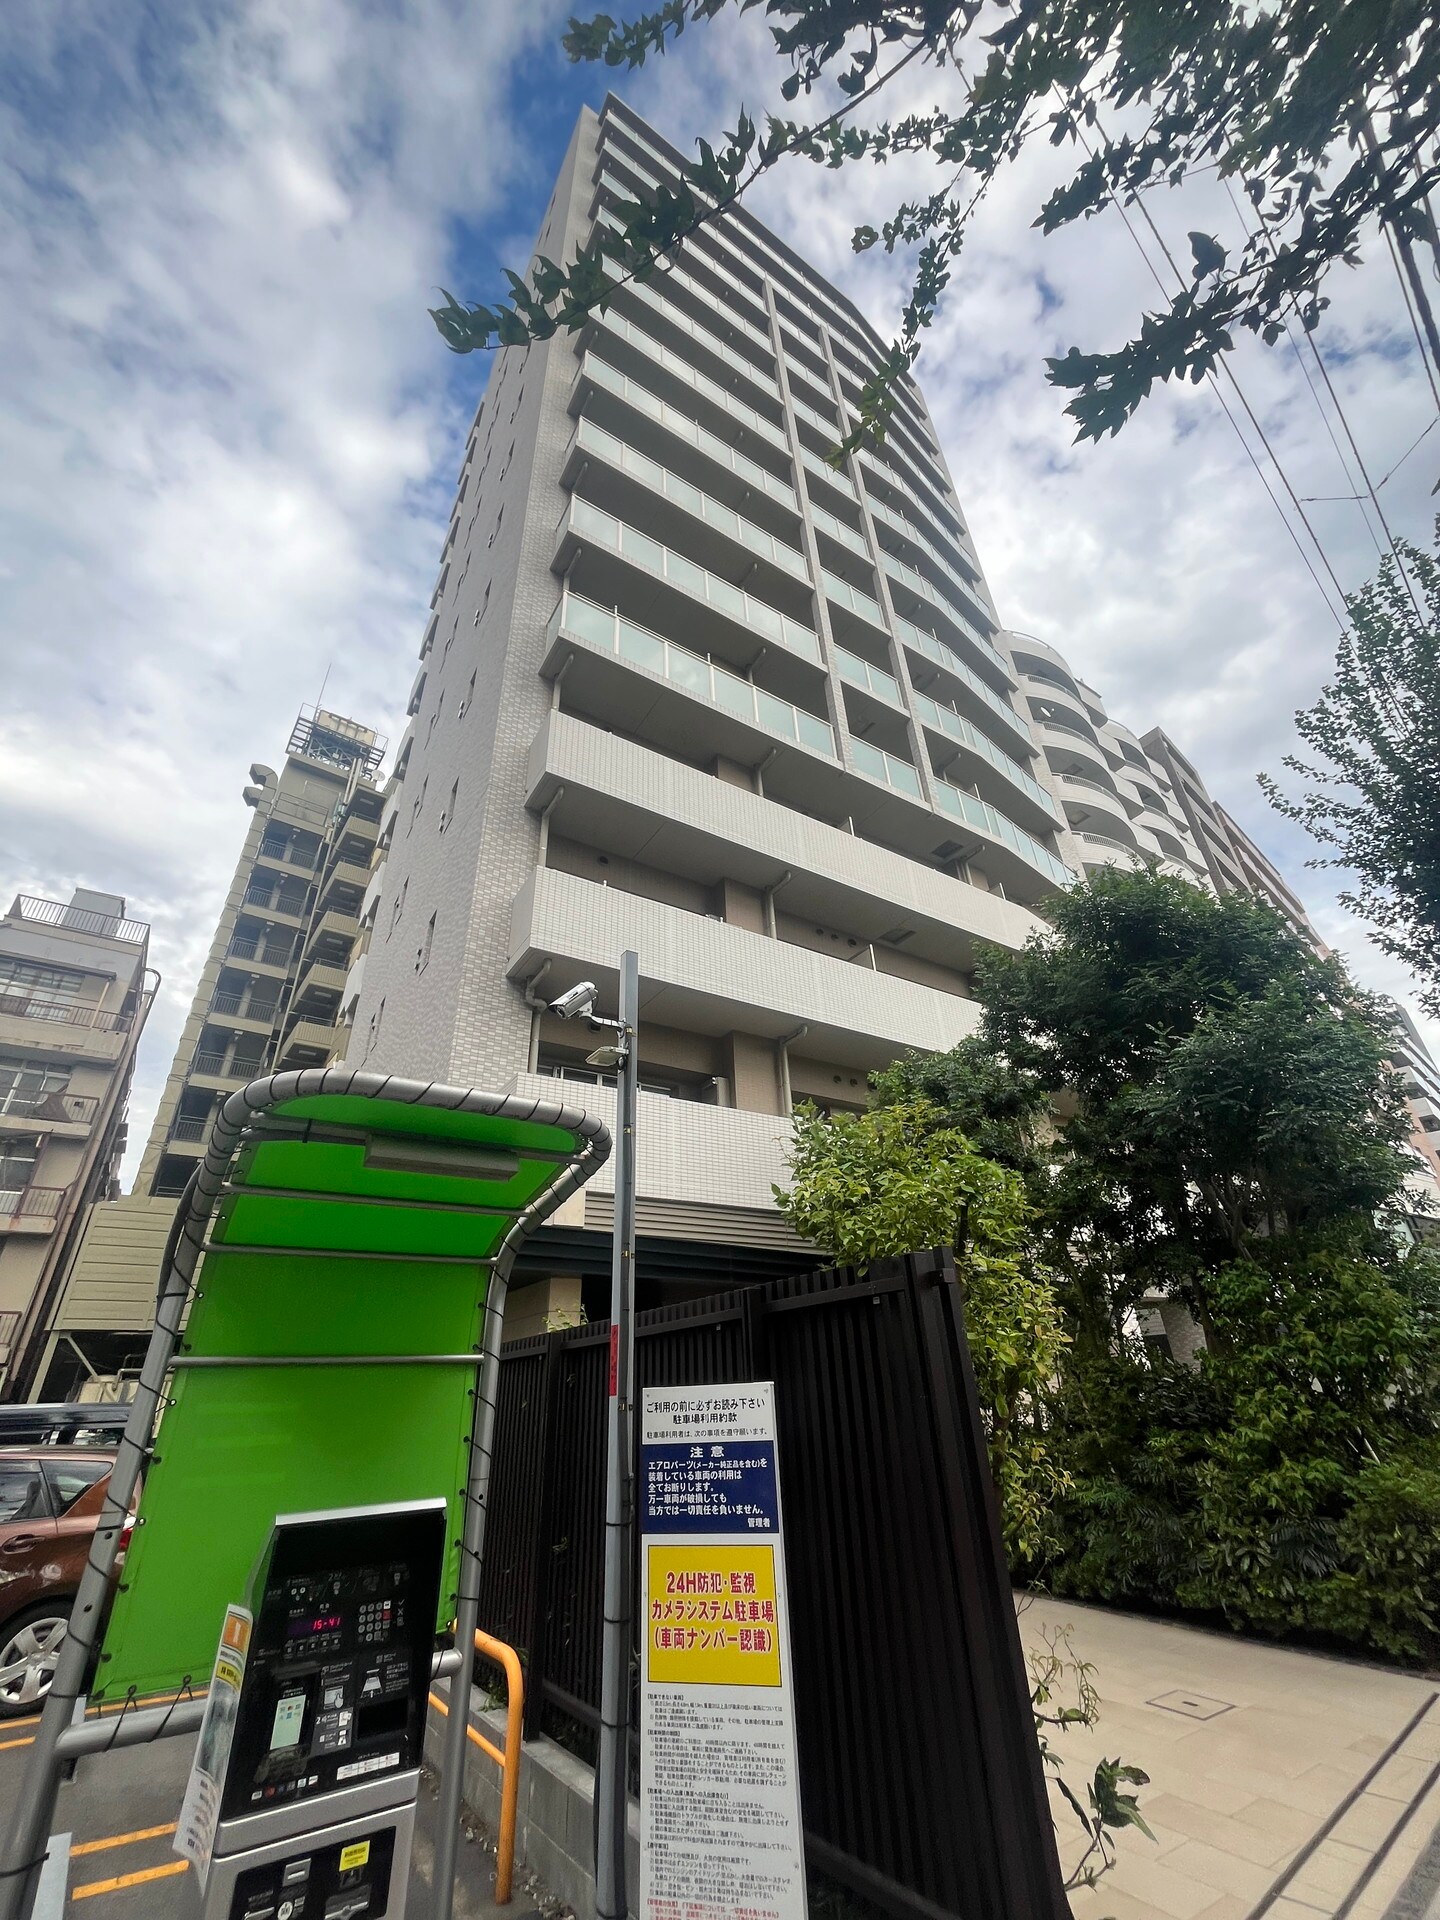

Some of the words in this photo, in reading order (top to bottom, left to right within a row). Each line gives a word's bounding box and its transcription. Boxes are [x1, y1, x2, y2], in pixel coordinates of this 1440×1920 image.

[646, 1398, 765, 1412] ご利用の前に必ずお読み下さい
[673, 1413, 737, 1424] 駐車場利用約款
[648, 1470, 742, 1481] 装着している車両の利用は
[648, 1482, 714, 1492] 全てお断りします。
[648, 1493, 727, 1504] 万一車両が破損しても
[648, 1504, 764, 1515] 当方では一切責任を負いません。
[748, 1518, 770, 1528] 管理者
[666, 1571, 756, 1594] 24H防犯・監視
[652, 1600, 774, 1622] カメラシステム駐車場
